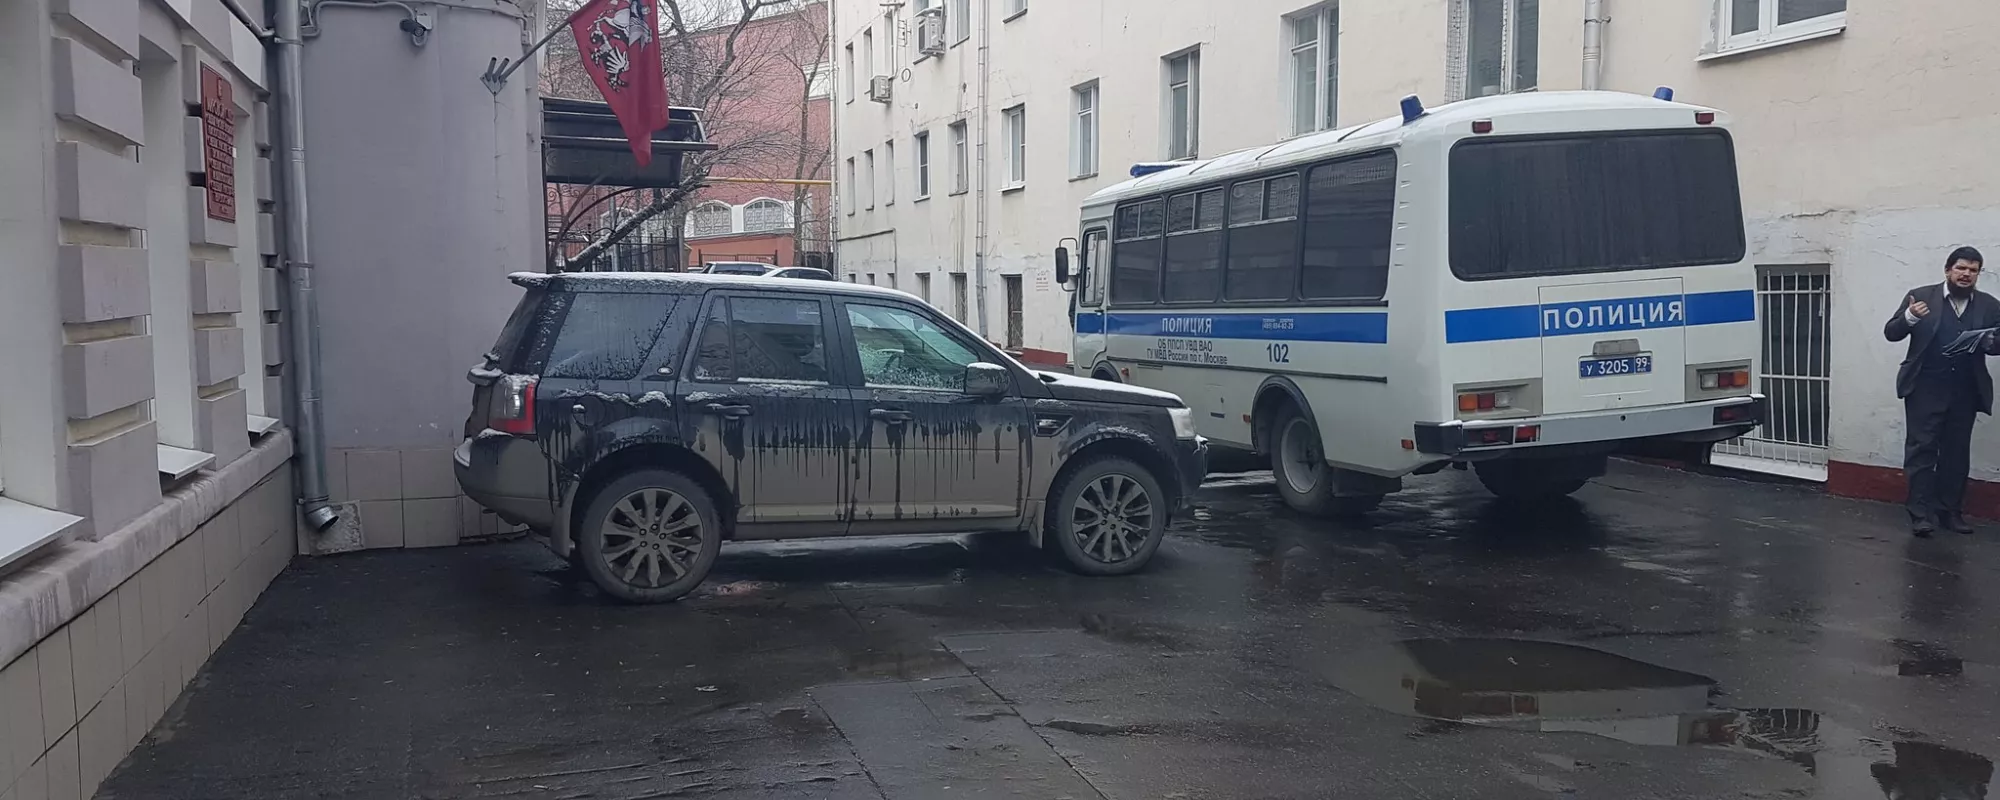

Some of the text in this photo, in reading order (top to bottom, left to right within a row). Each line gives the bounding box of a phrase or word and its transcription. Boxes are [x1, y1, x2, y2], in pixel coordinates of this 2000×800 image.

[1543, 301, 1682, 330] ПОЛИЦИЯ
[1161, 317, 1213, 335] ПОЛИЦИЯ
[1157, 339, 1212, 352] ОБ ППСП УВД ВАО
[1266, 343, 1290, 363] 102
[1146, 348, 1154, 359] ГУ
[1154, 348, 1167, 360] МВД
[1168, 350, 1188, 361] России
[1189, 353, 1197, 362] по
[1203, 352, 1228, 364] Москве
[1598, 359, 1629, 375] 3205
[1635, 357, 1648, 368] 99
